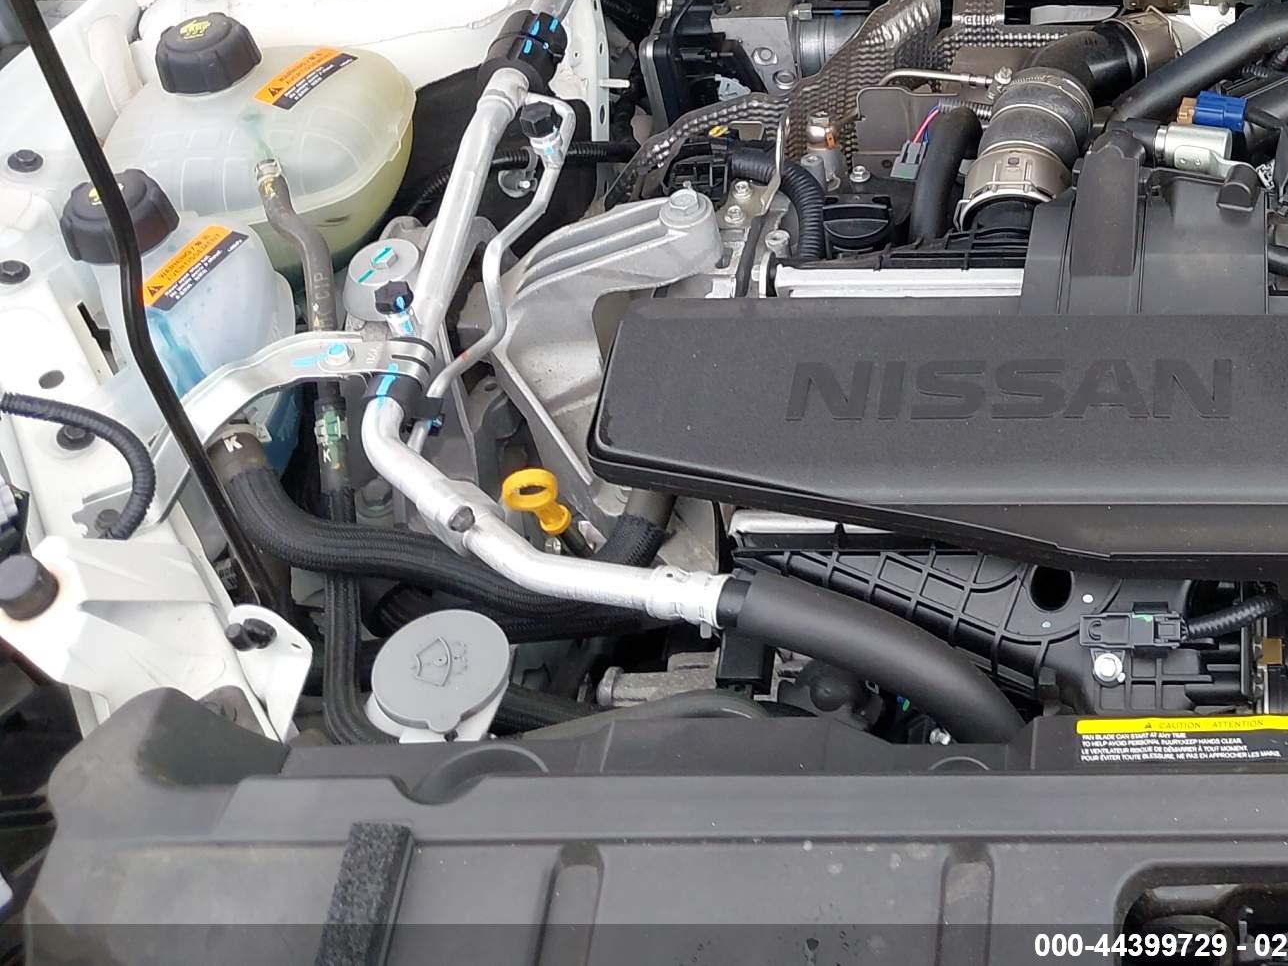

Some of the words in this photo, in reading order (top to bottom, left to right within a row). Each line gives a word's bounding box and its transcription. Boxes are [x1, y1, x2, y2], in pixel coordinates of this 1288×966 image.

[785, 358, 1232, 421] NISSAN
[223, 434, 243, 453] K
[322, 448, 332, 463] K
[1159, 721, 1201, 730] CAUTION
[1213, 719, 1264, 728] ATTENTION
